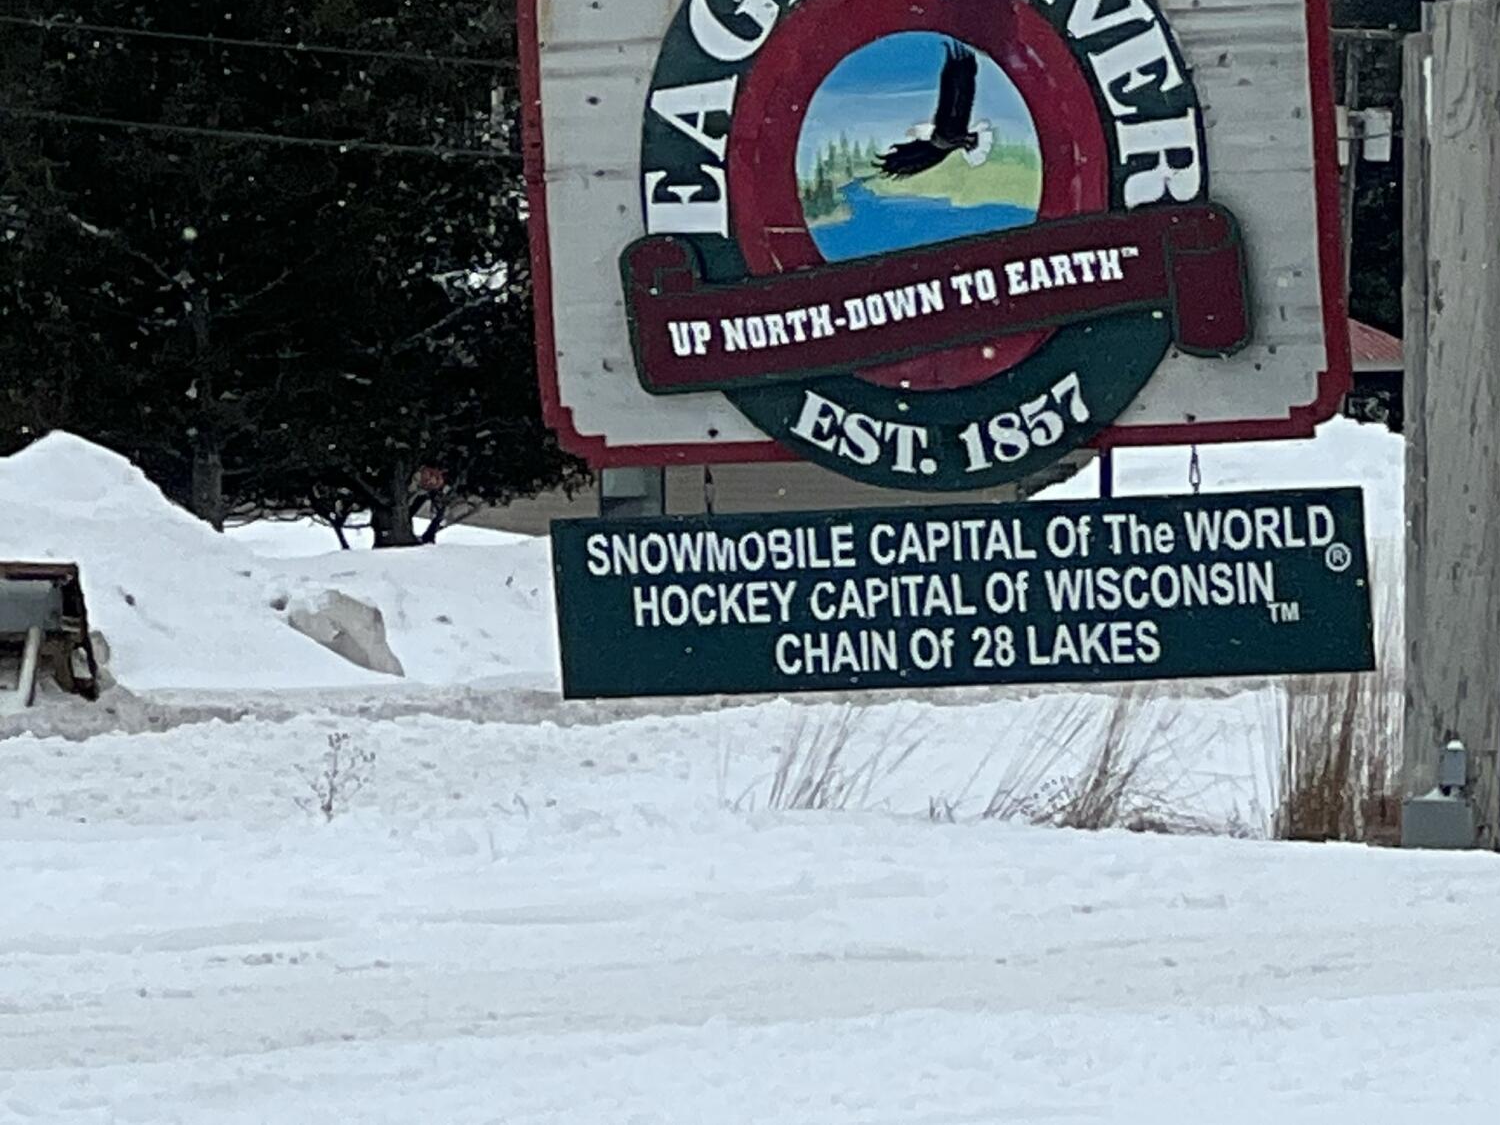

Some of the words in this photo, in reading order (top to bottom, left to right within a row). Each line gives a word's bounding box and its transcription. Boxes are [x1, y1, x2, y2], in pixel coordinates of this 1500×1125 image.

[667, 321, 711, 357] UP
[720, 280, 944, 352] NORTH-DOWN
[951, 269, 997, 306] TO
[790, 390, 938, 475] EST.
[959, 372, 1092, 474] 1857
[586, 522, 857, 576] SNOWMOBILE
[869, 518, 1037, 565] CAPITAL
[1046, 514, 1092, 559] Of
[1103, 512, 1176, 556] The
[632, 579, 797, 627] HOCKEY
[810, 571, 977, 621] CAPITAL
[986, 569, 1030, 614] Of
[1045, 560, 1275, 612] WISCONSIN
[775, 628, 898, 675] CHAIN
[909, 627, 955, 670] Of
[971, 625, 1016, 668] 28
[1026, 619, 1162, 666] LAKES
